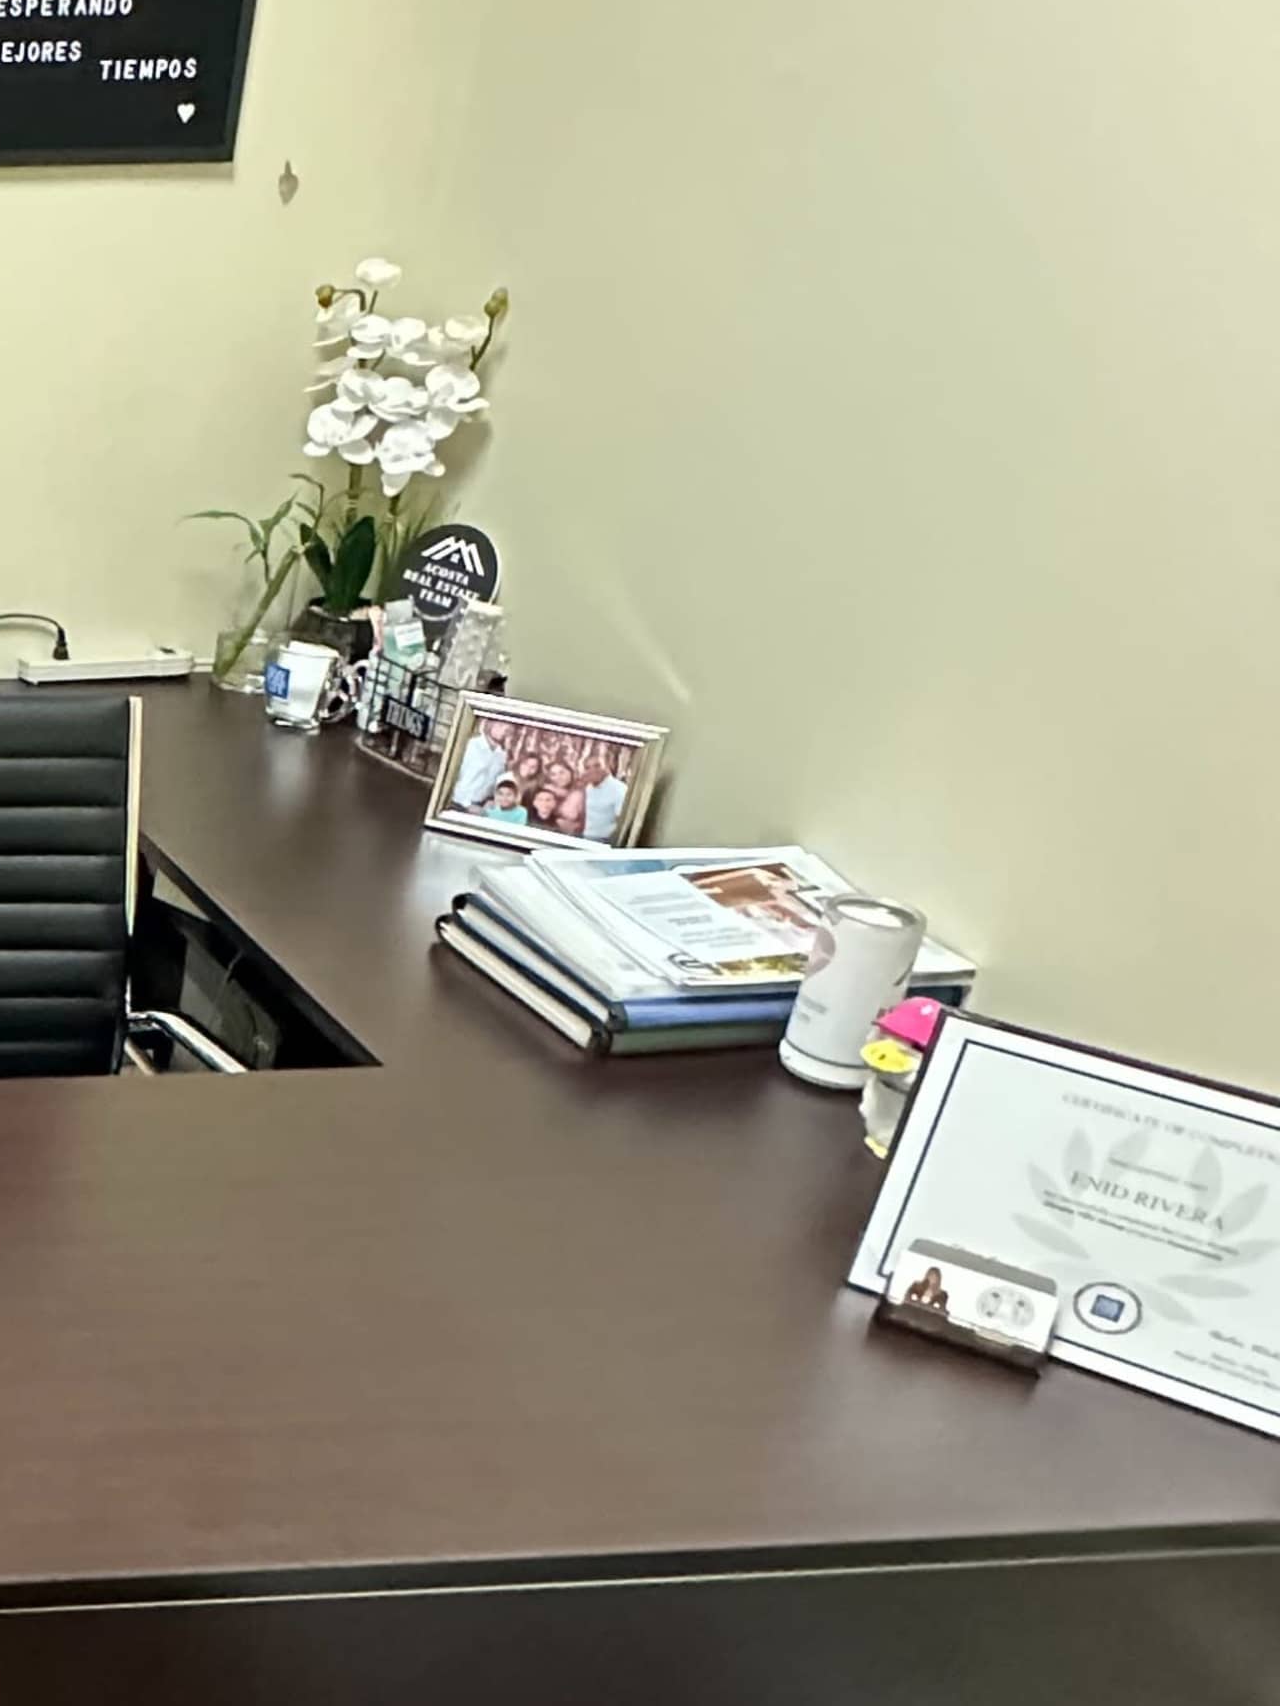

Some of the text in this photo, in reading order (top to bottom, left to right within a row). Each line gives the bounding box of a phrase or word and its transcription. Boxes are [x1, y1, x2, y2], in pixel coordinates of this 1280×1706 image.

[99, 57, 197, 80] TIEMPOS
[403, 569, 434, 592] REAL
[424, 562, 469, 586] ACOSTA
[419, 589, 453, 608] TEAM
[1070, 1169, 1129, 1201] ENID
[1132, 1190, 1225, 1232] RIVERA
